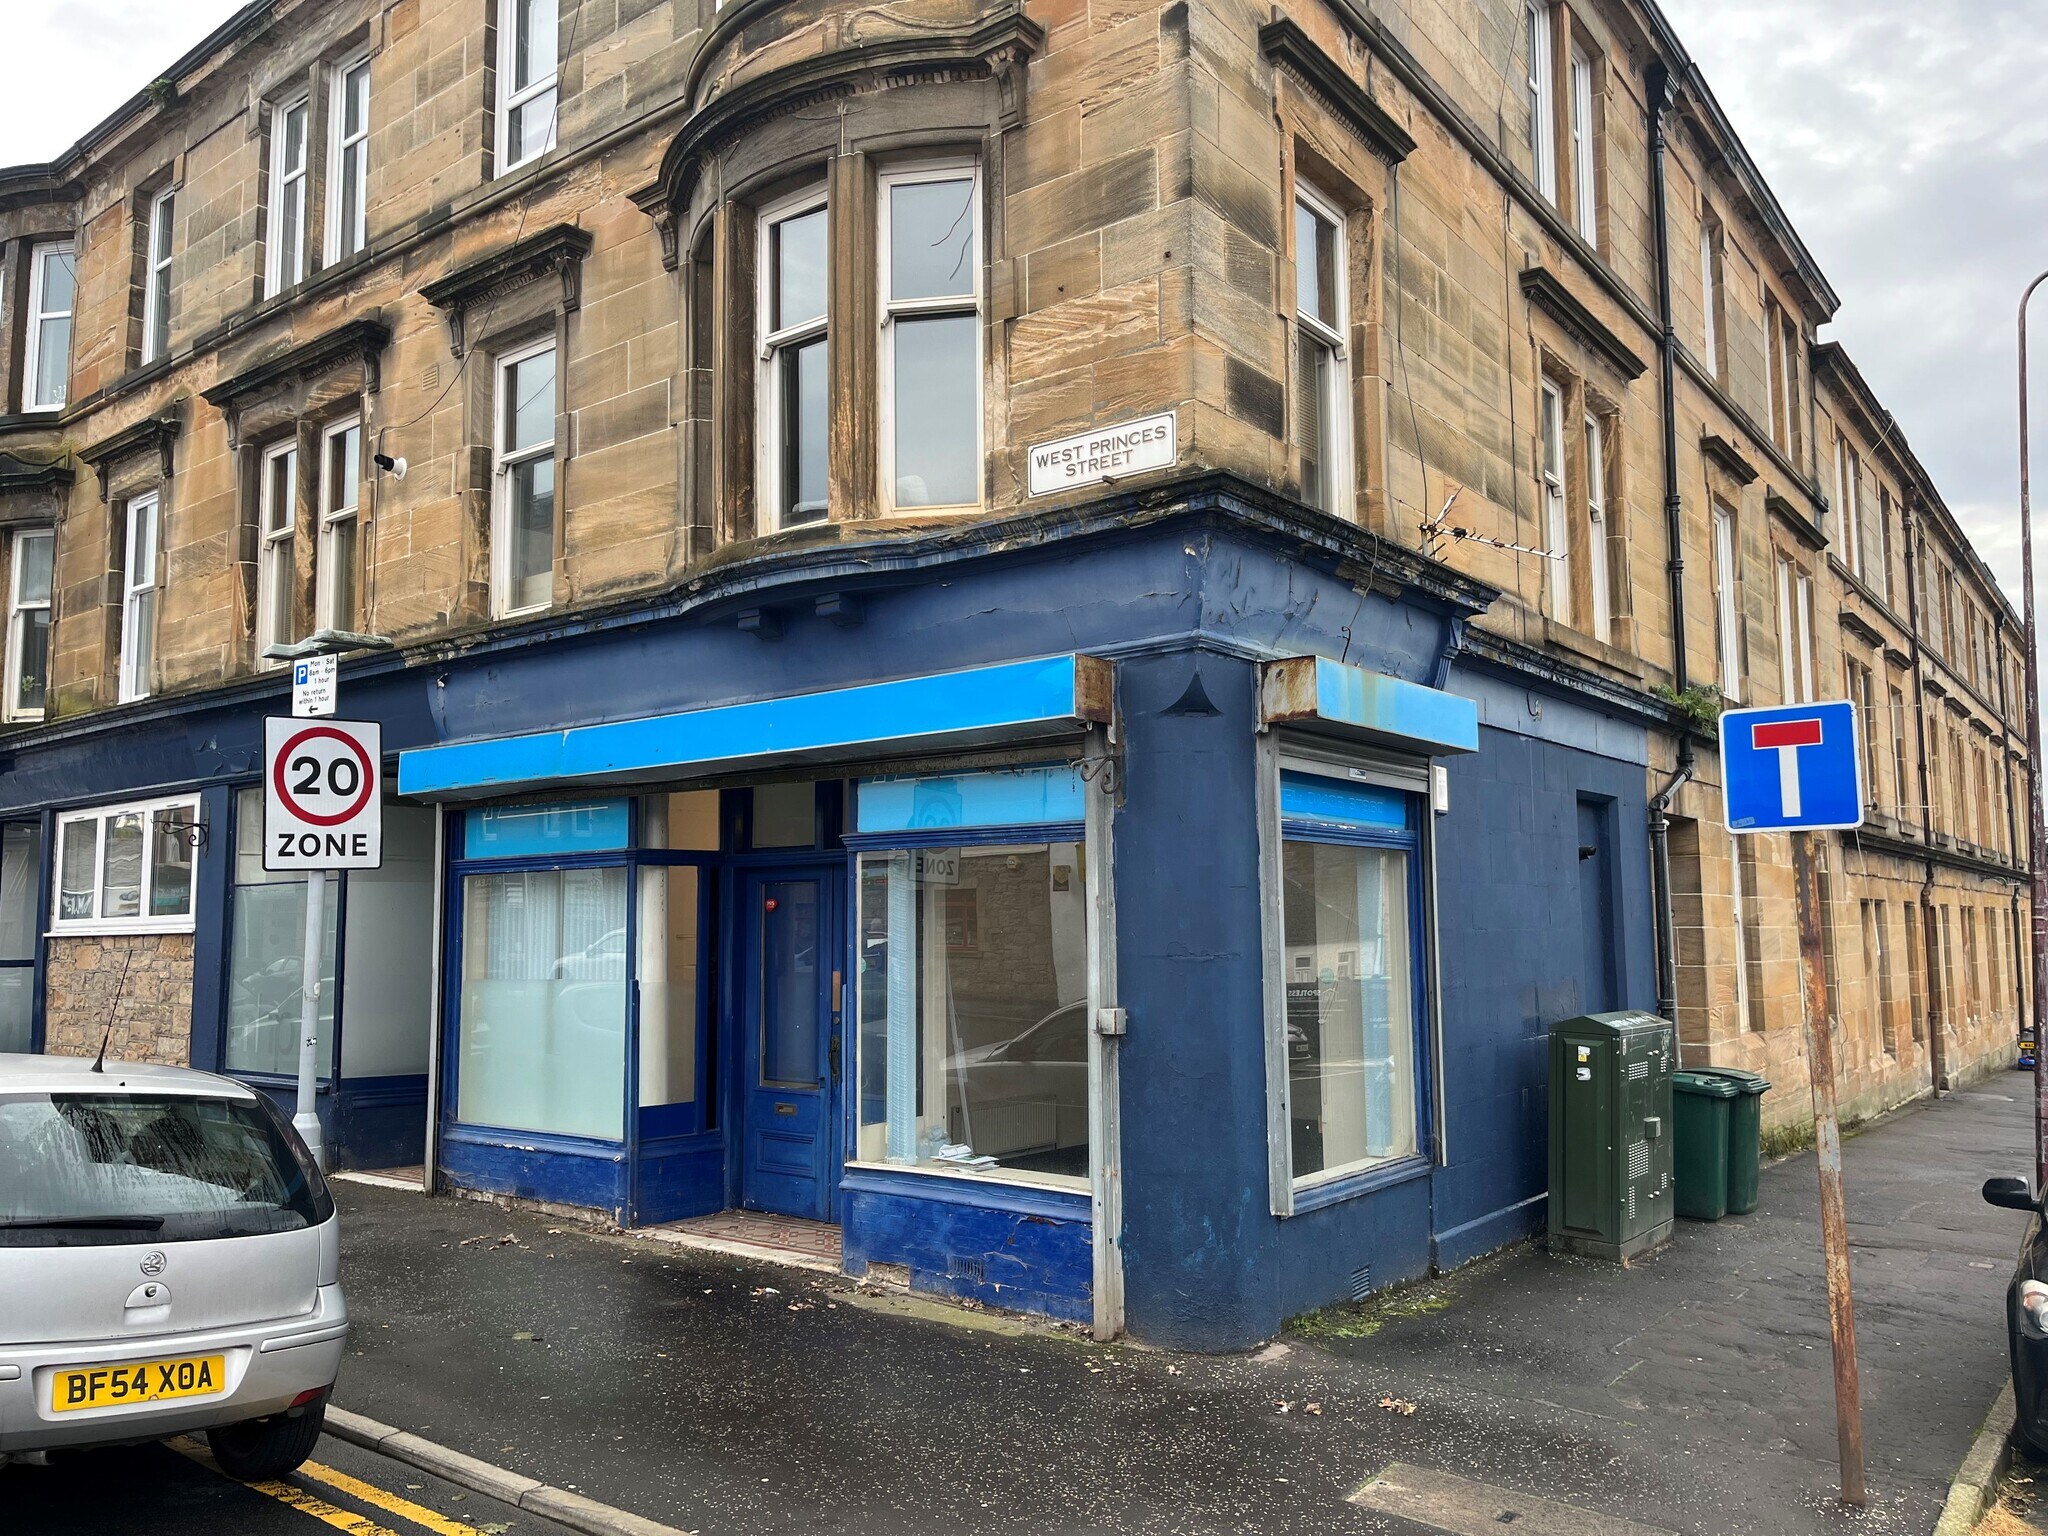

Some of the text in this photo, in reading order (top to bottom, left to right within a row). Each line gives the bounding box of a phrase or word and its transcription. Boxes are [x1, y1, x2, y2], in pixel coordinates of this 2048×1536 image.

[1036, 425, 1167, 468] WEST PRINCES
[1065, 449, 1134, 477] STREET
[311, 688, 326, 696] return
[291, 756, 359, 797] 20
[277, 833, 368, 858] ZONE
[67, 1360, 213, 1404] BF54 XOA
